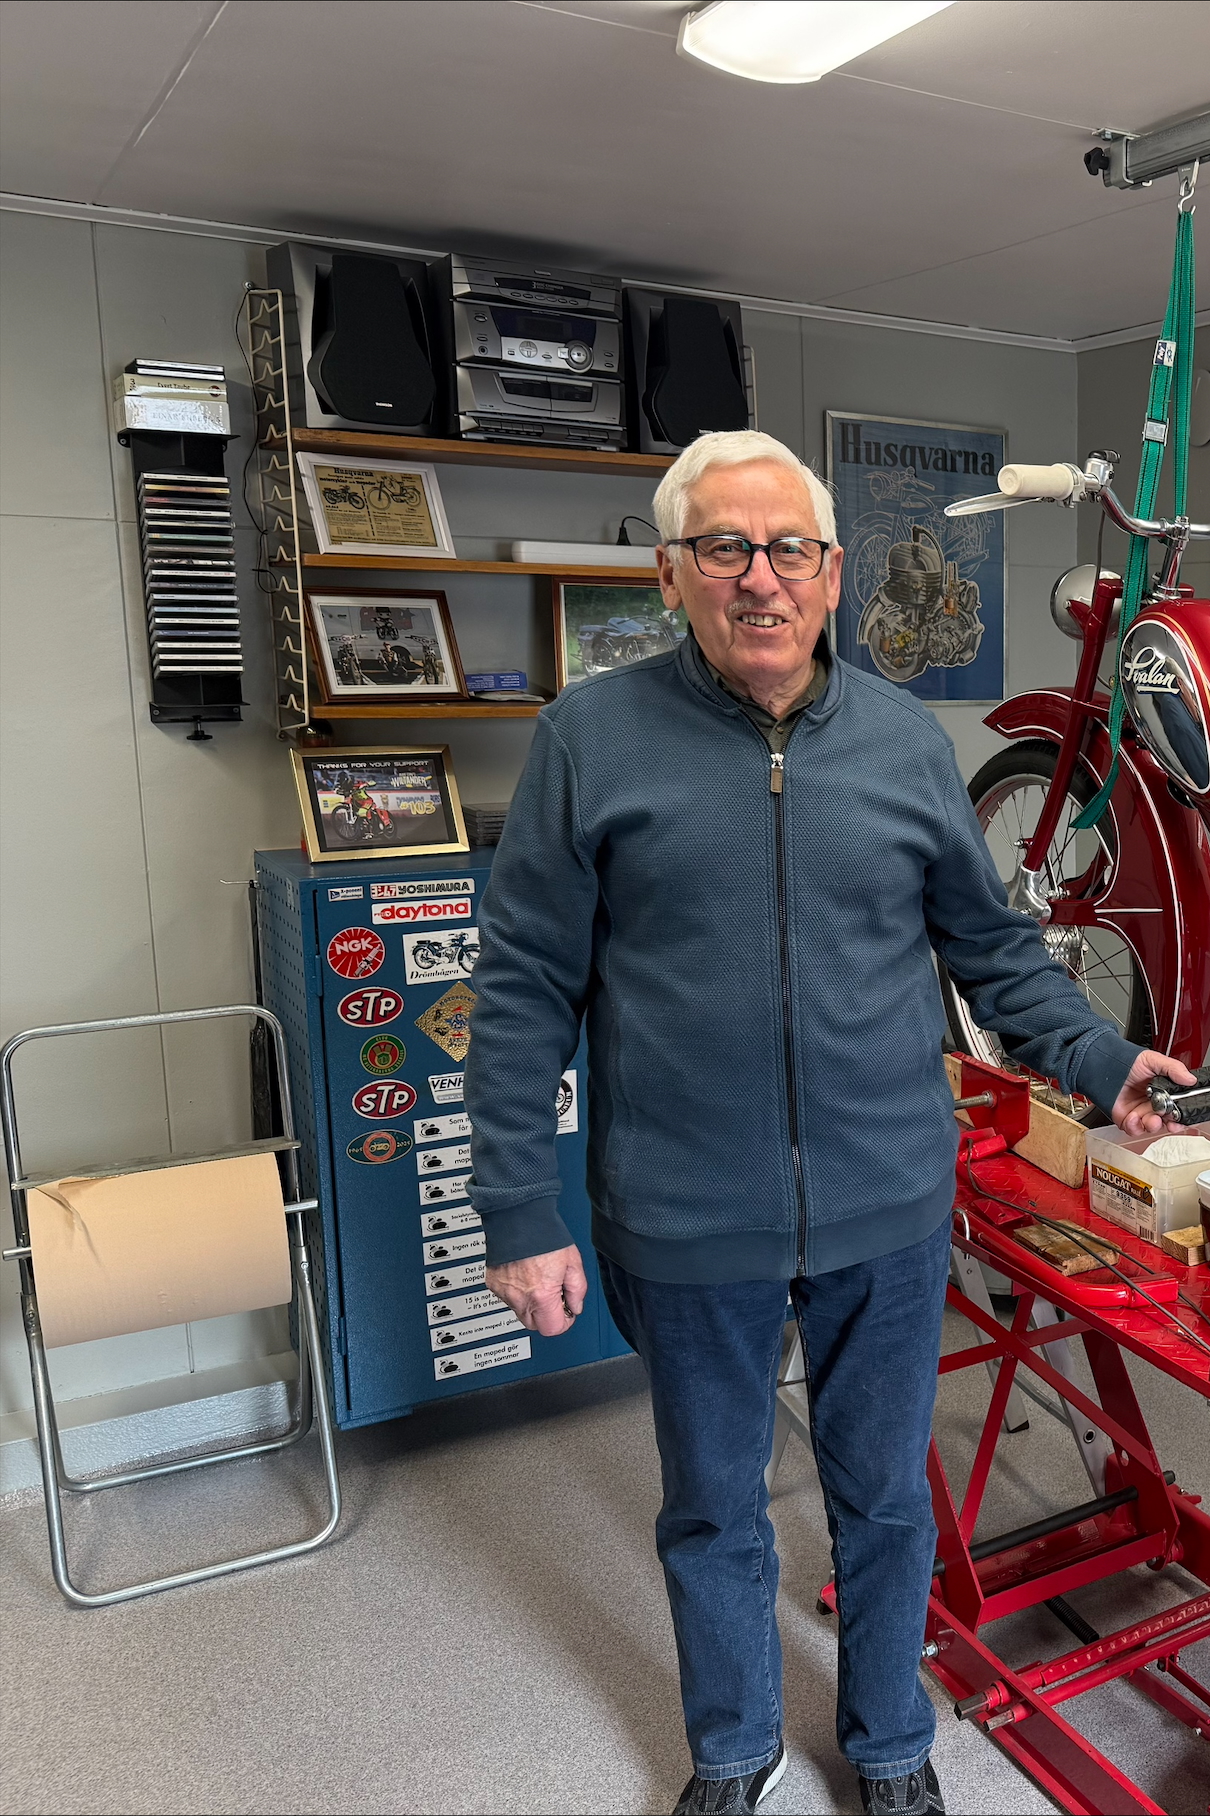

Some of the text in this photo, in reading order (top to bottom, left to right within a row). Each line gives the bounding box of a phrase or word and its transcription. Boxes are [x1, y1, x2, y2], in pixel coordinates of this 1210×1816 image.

[839, 422, 996, 478] Husqvarna
[400, 800, 436, 815] #103
[398, 881, 471, 895] YOSHIMURA
[381, 901, 469, 920] daytona
[335, 937, 373, 955] NGK
[346, 991, 396, 1021] STP
[360, 1085, 409, 1114] STP
[1096, 1167, 1132, 1191] NOUGAT
[462, 1272, 485, 1282] moped
[484, 1346, 506, 1356] moped
[507, 1344, 518, 1352] gör
[474, 1352, 519, 1367] ingen sommar
